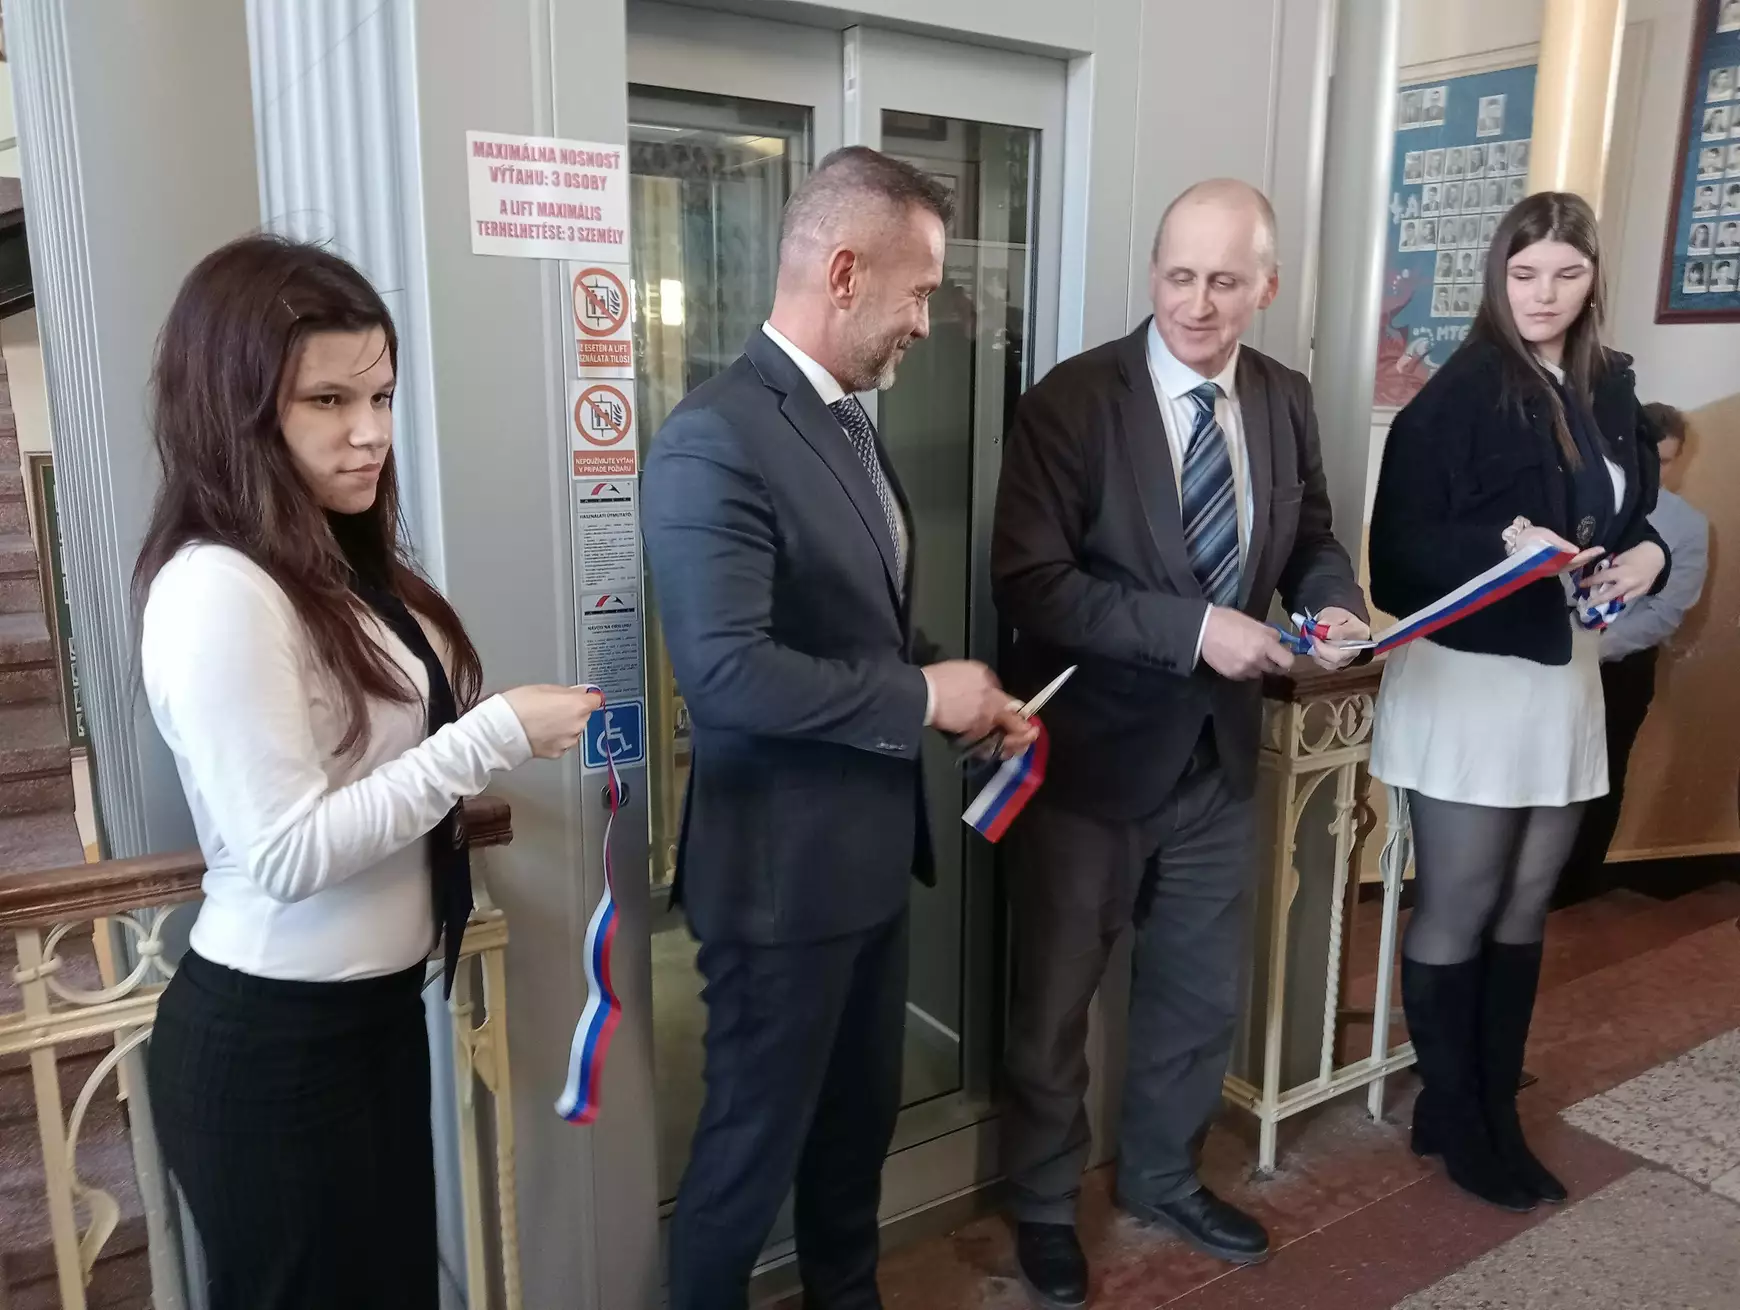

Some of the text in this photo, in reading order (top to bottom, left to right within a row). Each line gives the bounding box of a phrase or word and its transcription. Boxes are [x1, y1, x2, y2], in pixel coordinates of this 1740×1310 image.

[472, 141, 621, 170] MAXIMÁLNA NOSNOSŤ
[488, 164, 608, 192] VÝŤAHU: 3 OSOBY
[500, 199, 602, 222] A LIFT MAXIMÁLIS
[476, 220, 624, 245] TERHELHETÉSE: 3 SZEMÉLY
[579, 353, 609, 363] SZNÁLATA
[584, 343, 607, 352] ESETÉN
[608, 344, 613, 352] A
[614, 344, 627, 353] LIFT
